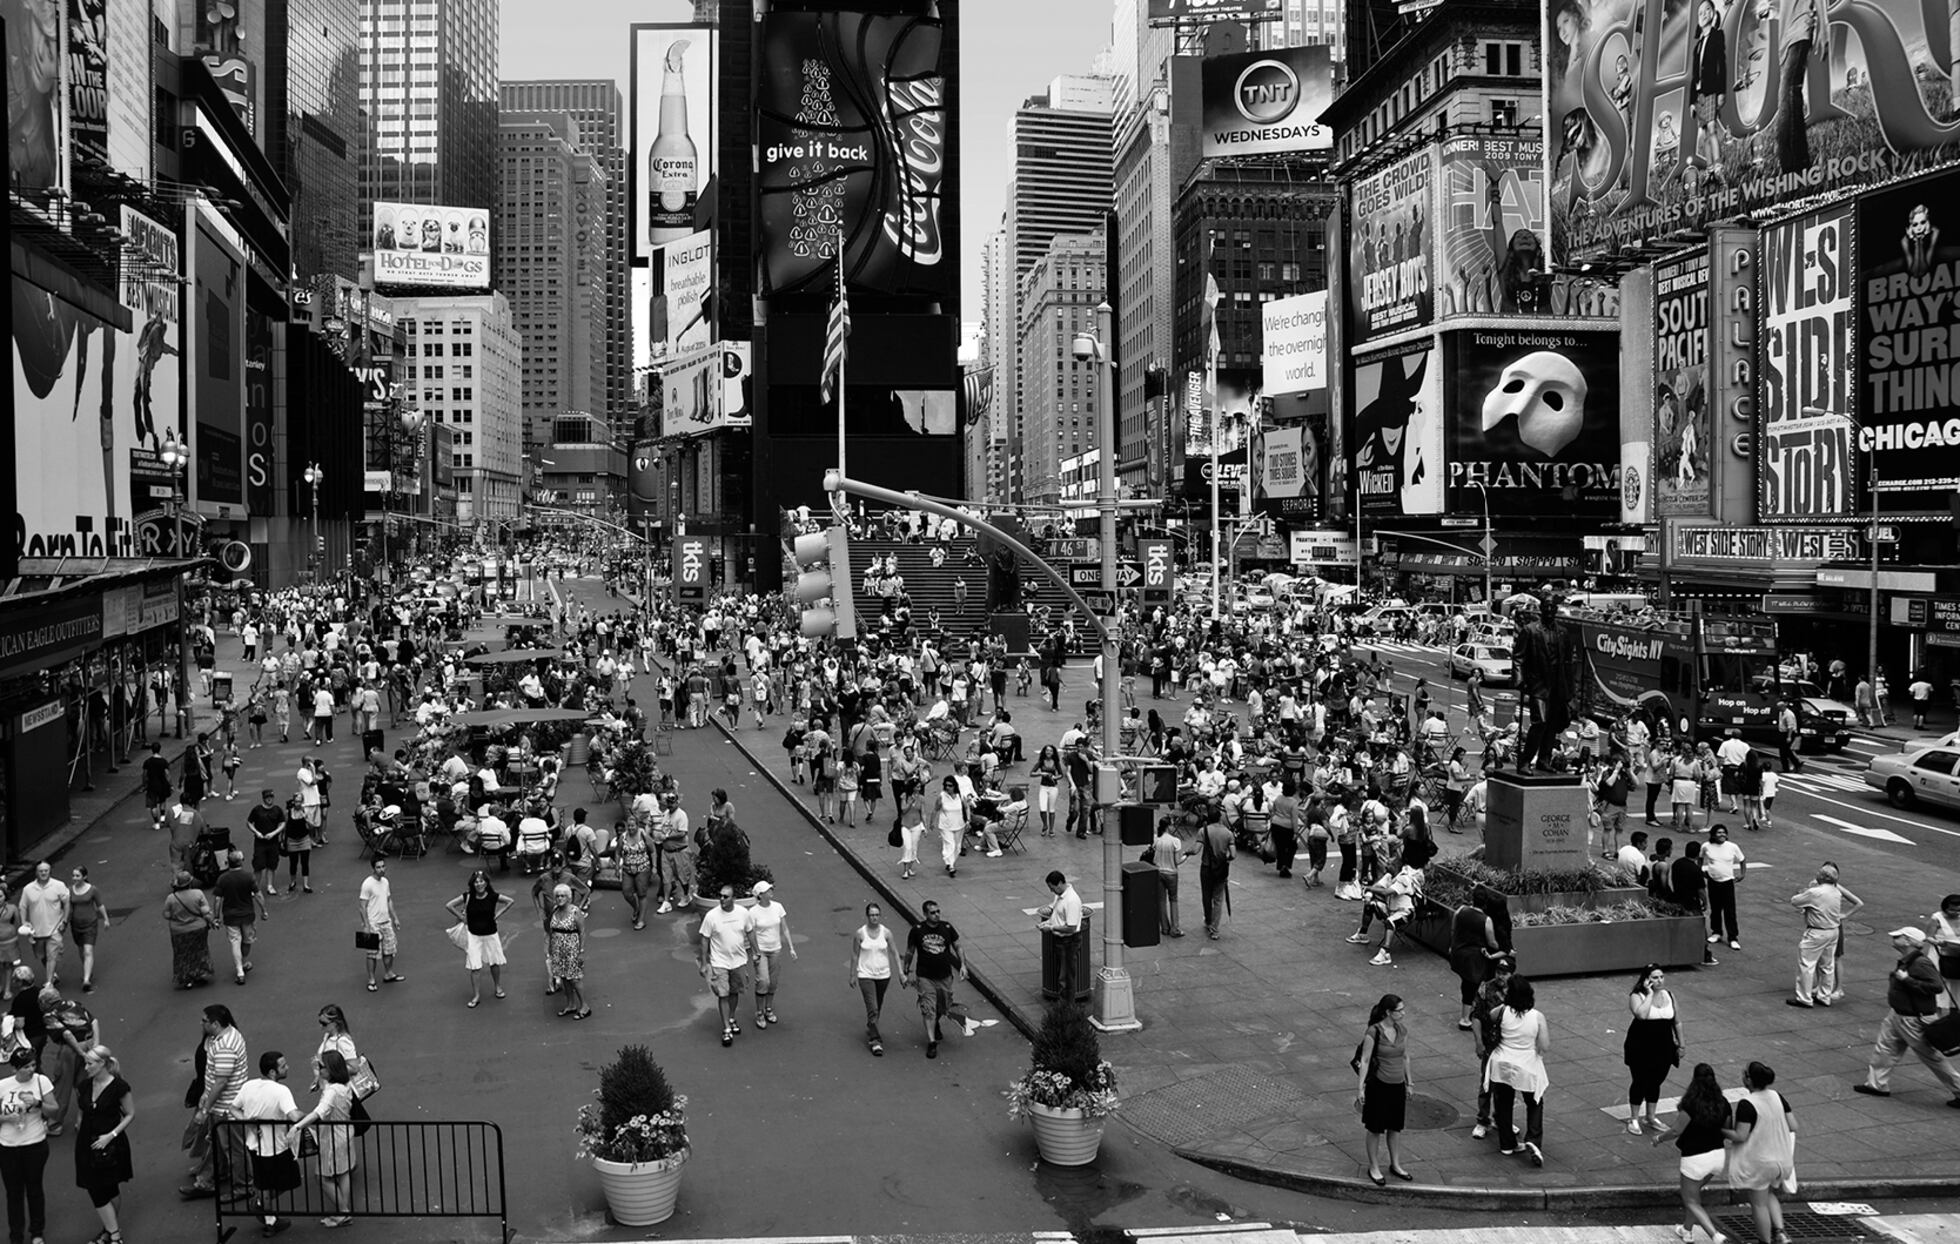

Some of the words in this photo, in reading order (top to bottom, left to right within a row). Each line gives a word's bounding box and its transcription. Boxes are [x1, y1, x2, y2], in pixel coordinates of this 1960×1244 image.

[1244, 83, 1291, 104] TNT
[1214, 125, 1320, 144] WEDNESDAYS
[766, 142, 804, 163] give
[808, 140, 824, 158] it
[828, 142, 868, 161] back
[1484, 141, 1513, 152] BEST
[1485, 152, 1511, 160] 2009
[1514, 153, 1538, 161] TONY
[653, 158, 694, 173] Corona
[662, 170, 688, 178] Extra
[1357, 178, 1380, 200] THE
[1383, 152, 1430, 189] CROWD
[1358, 189, 1391, 218] GOES
[1393, 170, 1429, 201] WILD!
[1566, 229, 1589, 249] THE
[1592, 205, 1681, 243] ADVENTURES
[1685, 194, 1707, 217] OF
[1709, 187, 1738, 211] THE
[1742, 165, 1823, 201] WISHING
[1827, 147, 1886, 181] ROCK
[575, 186, 588, 287] NOVOTEL
[668, 244, 710, 268] INGLOT
[670, 271, 706, 292] breathable
[1361, 264, 1399, 313] JERSEY
[1400, 253, 1428, 300] BOYS
[1868, 260, 1960, 304] BROA
[677, 292, 699, 310] polish
[1658, 289, 1707, 336] SOUT
[1265, 315, 1290, 332] We're
[1269, 341, 1285, 357] the
[1473, 332, 1515, 349] Tonight
[1518, 332, 1561, 349] belongs
[1564, 336, 1588, 348] to...
[1731, 248, 1750, 458] PALACE
[1285, 361, 1316, 380] world.
[1765, 310, 1851, 425] SIDE
[1449, 461, 1621, 490] PHANTOM
[1282, 499, 1313, 511] SEPHORA
[1061, 541, 1073, 556] 46
[1076, 541, 1085, 550] ST
[1682, 531, 1707, 555] WEST
[1711, 531, 1736, 556] SIDE
[1739, 531, 1768, 557] STORY
[1782, 532, 1824, 558] WEST
[683, 541, 703, 583] tkts
[1148, 544, 1168, 586] tkts
[1080, 571, 1101, 582] ONE
[1934, 602, 1957, 611] TIMES
[27, 623, 55, 649] EAGLE
[56, 613, 100, 641] OUTFITTERS
[1649, 640, 1664, 660] NY
[1718, 697, 1735, 709] Hop
[1743, 706, 1759, 716] Hop
[1760, 706, 1771, 715] off
[1541, 814, 1570, 823] GEORGE
[1543, 829, 1569, 837] COHAN
